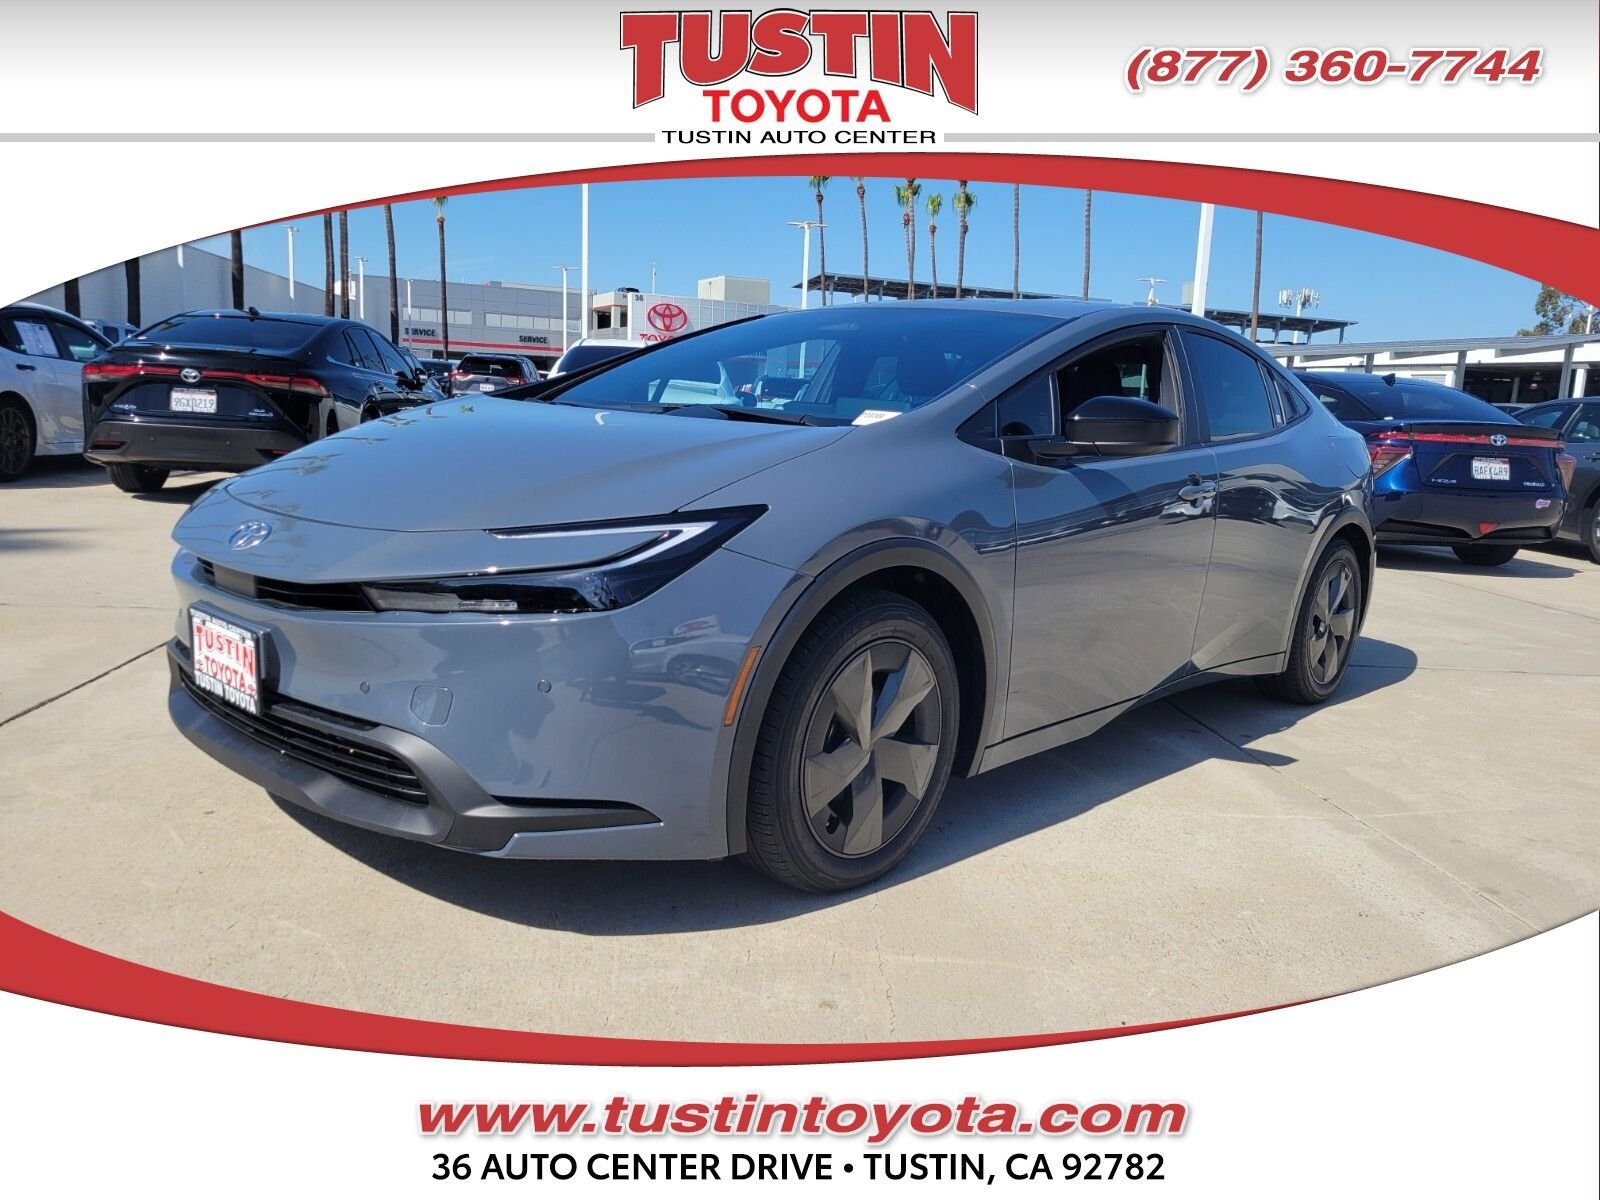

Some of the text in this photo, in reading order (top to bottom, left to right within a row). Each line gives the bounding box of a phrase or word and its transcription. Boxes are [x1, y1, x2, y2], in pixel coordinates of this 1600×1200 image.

[518, 335, 548, 344] SERVICE
[195, 624, 254, 677] TUSTIN
[194, 671, 257, 714] TUSTIN TOYOTA
[204, 655, 246, 691] TOYOTA
